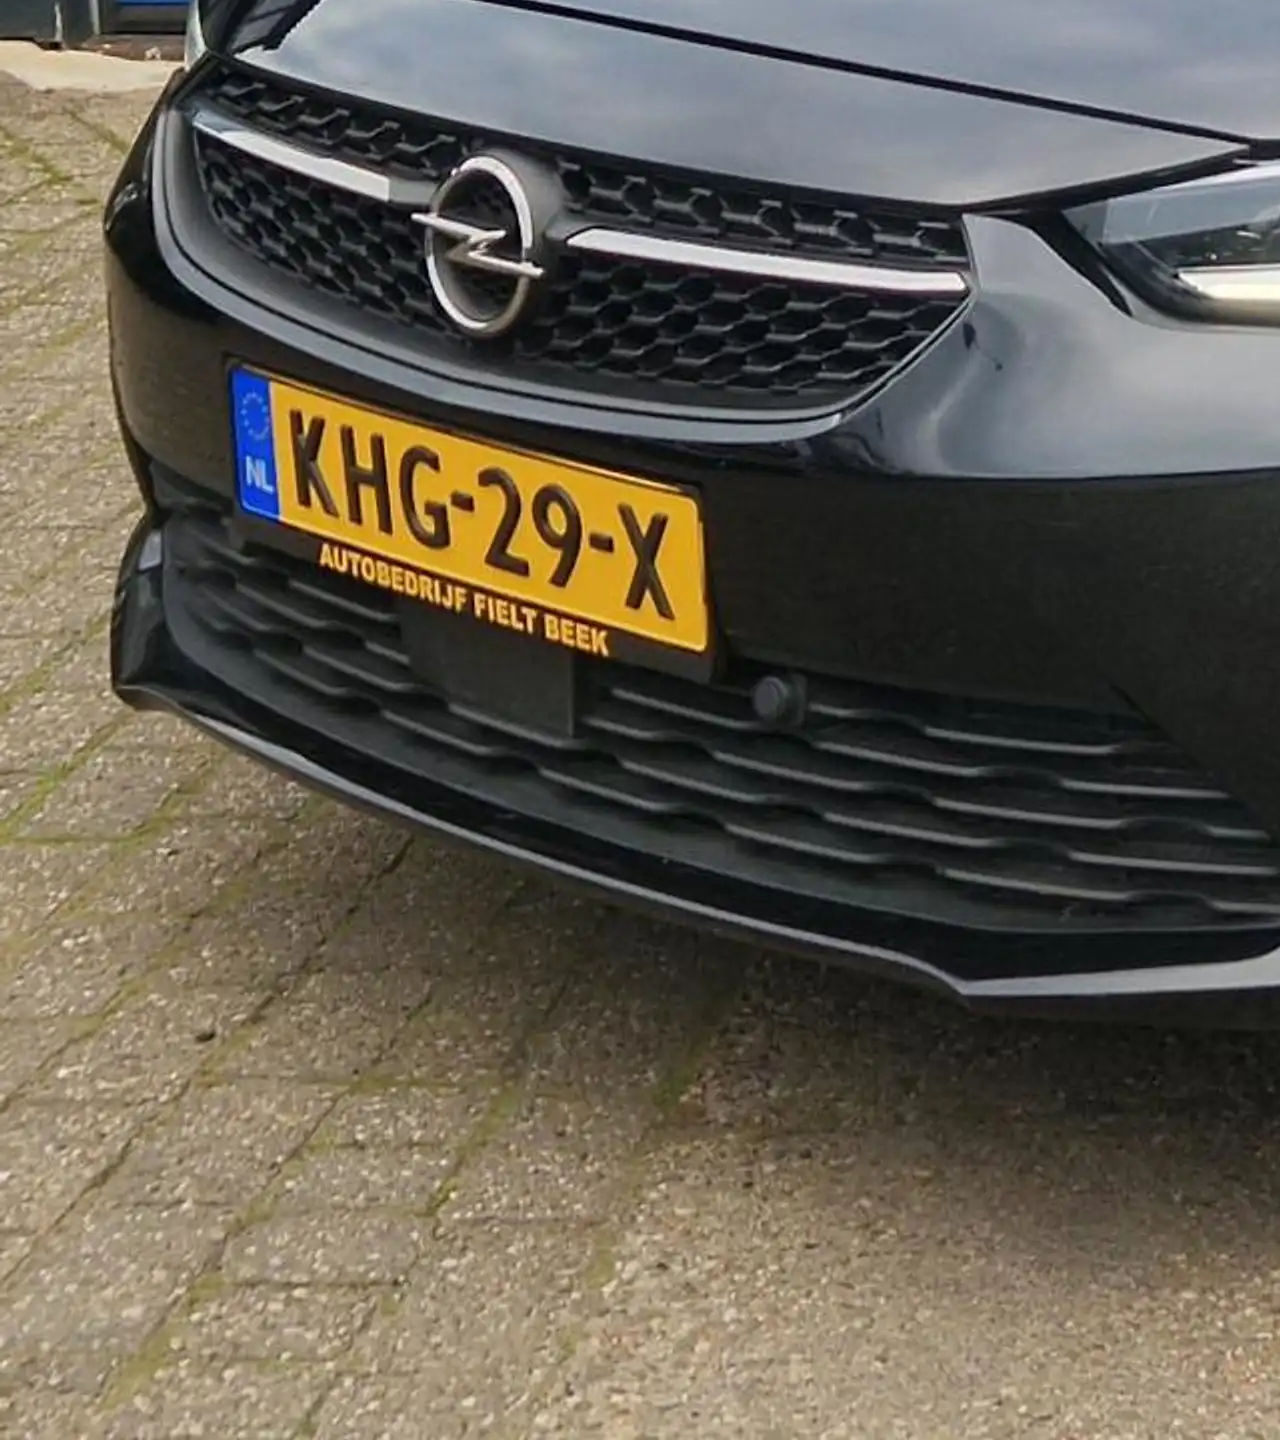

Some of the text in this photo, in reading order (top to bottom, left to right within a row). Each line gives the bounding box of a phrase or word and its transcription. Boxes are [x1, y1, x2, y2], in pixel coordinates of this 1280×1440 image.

[245, 456, 275, 494] NL
[289, 408, 676, 622] KHG-29-X
[319, 542, 609, 657] AUTOBEDRIJF FIELT BEEK
